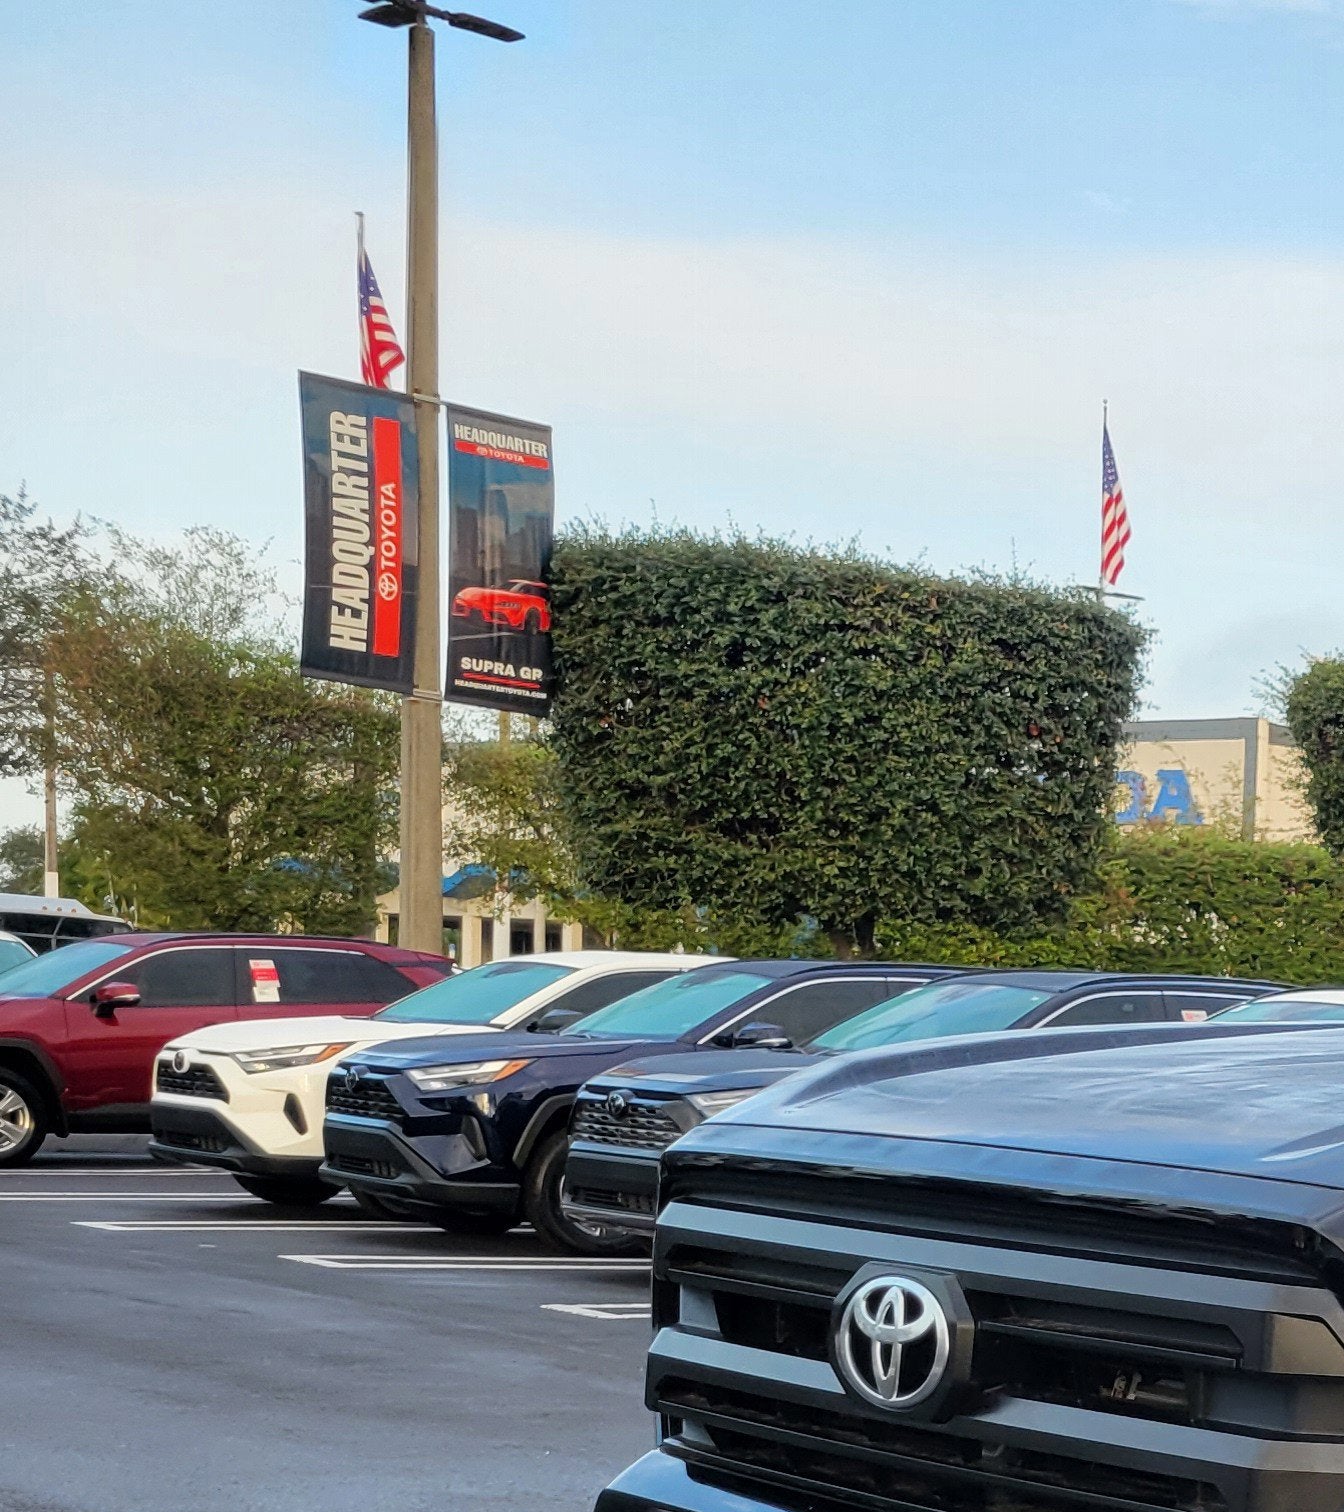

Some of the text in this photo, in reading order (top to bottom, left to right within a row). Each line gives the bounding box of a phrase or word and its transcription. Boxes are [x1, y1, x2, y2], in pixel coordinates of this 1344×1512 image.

[454, 423, 548, 458] HEADQUARTER
[489, 448, 525, 463] TOYOTA
[329, 410, 375, 652] HEADQUARTER
[379, 482, 397, 571] TOYOTA
[460, 656, 516, 678] SUPRA
